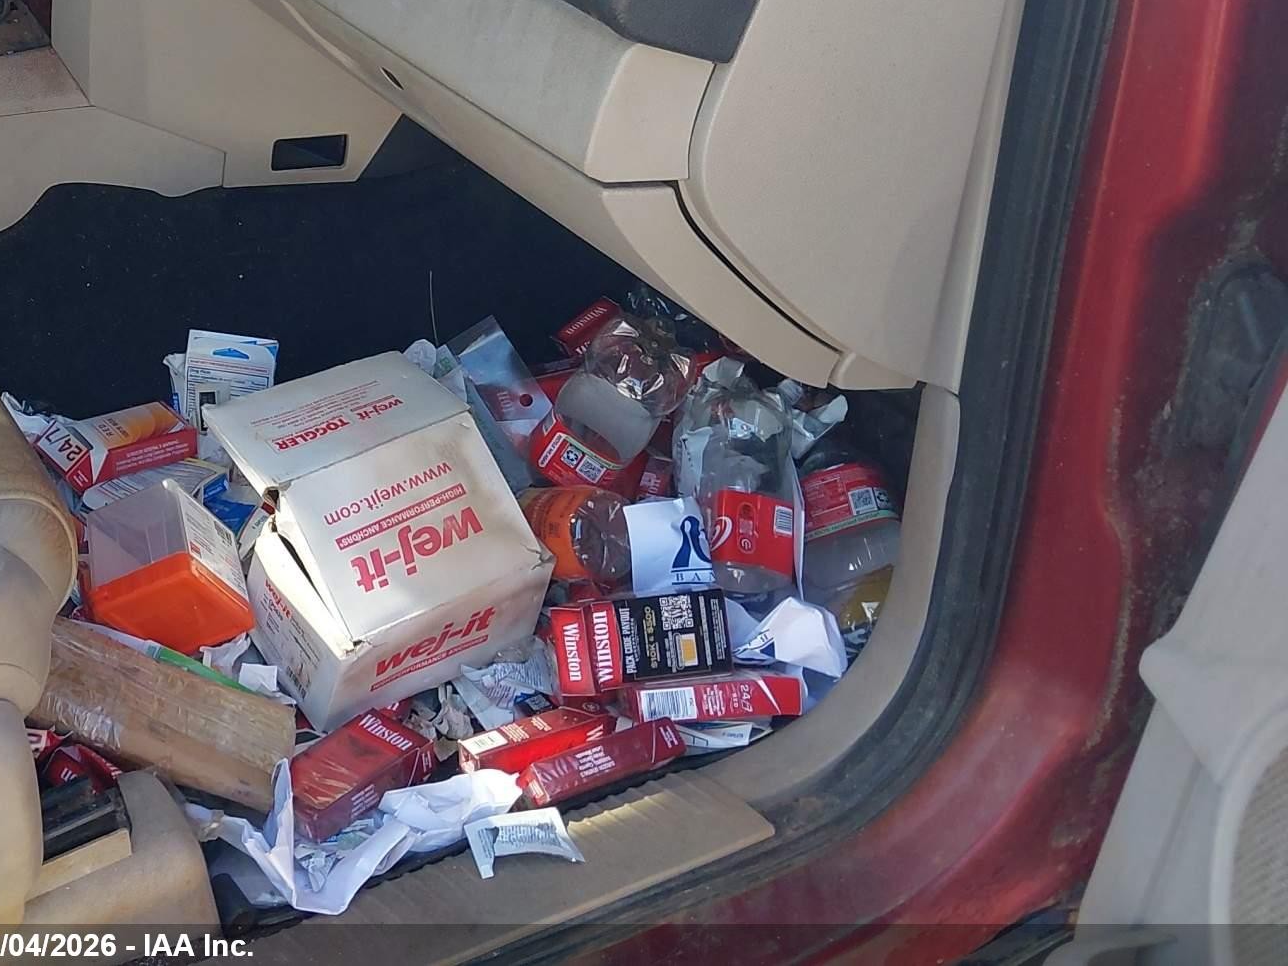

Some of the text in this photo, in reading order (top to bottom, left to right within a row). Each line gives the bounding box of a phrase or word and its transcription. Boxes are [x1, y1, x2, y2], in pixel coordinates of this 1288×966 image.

[565, 306, 608, 336] Winston
[356, 398, 404, 421] wej-it
[45, 427, 84, 461] 24/7
[275, 417, 350, 451] TOGGLER
[324, 462, 452, 525] www.wejit.com
[382, 487, 464, 530] HIGH-PERFORMANCE
[350, 505, 484, 593] wej-it
[619, 607, 631, 635] PAYOUT
[376, 606, 496, 677] wej-it
[563, 623, 582, 682] Winston
[592, 610, 614, 684] Winston
[623, 635, 633, 654] CODE
[625, 654, 638, 674] PACK
[740, 684, 754, 713] 24/7
[358, 713, 413, 751] Winston
